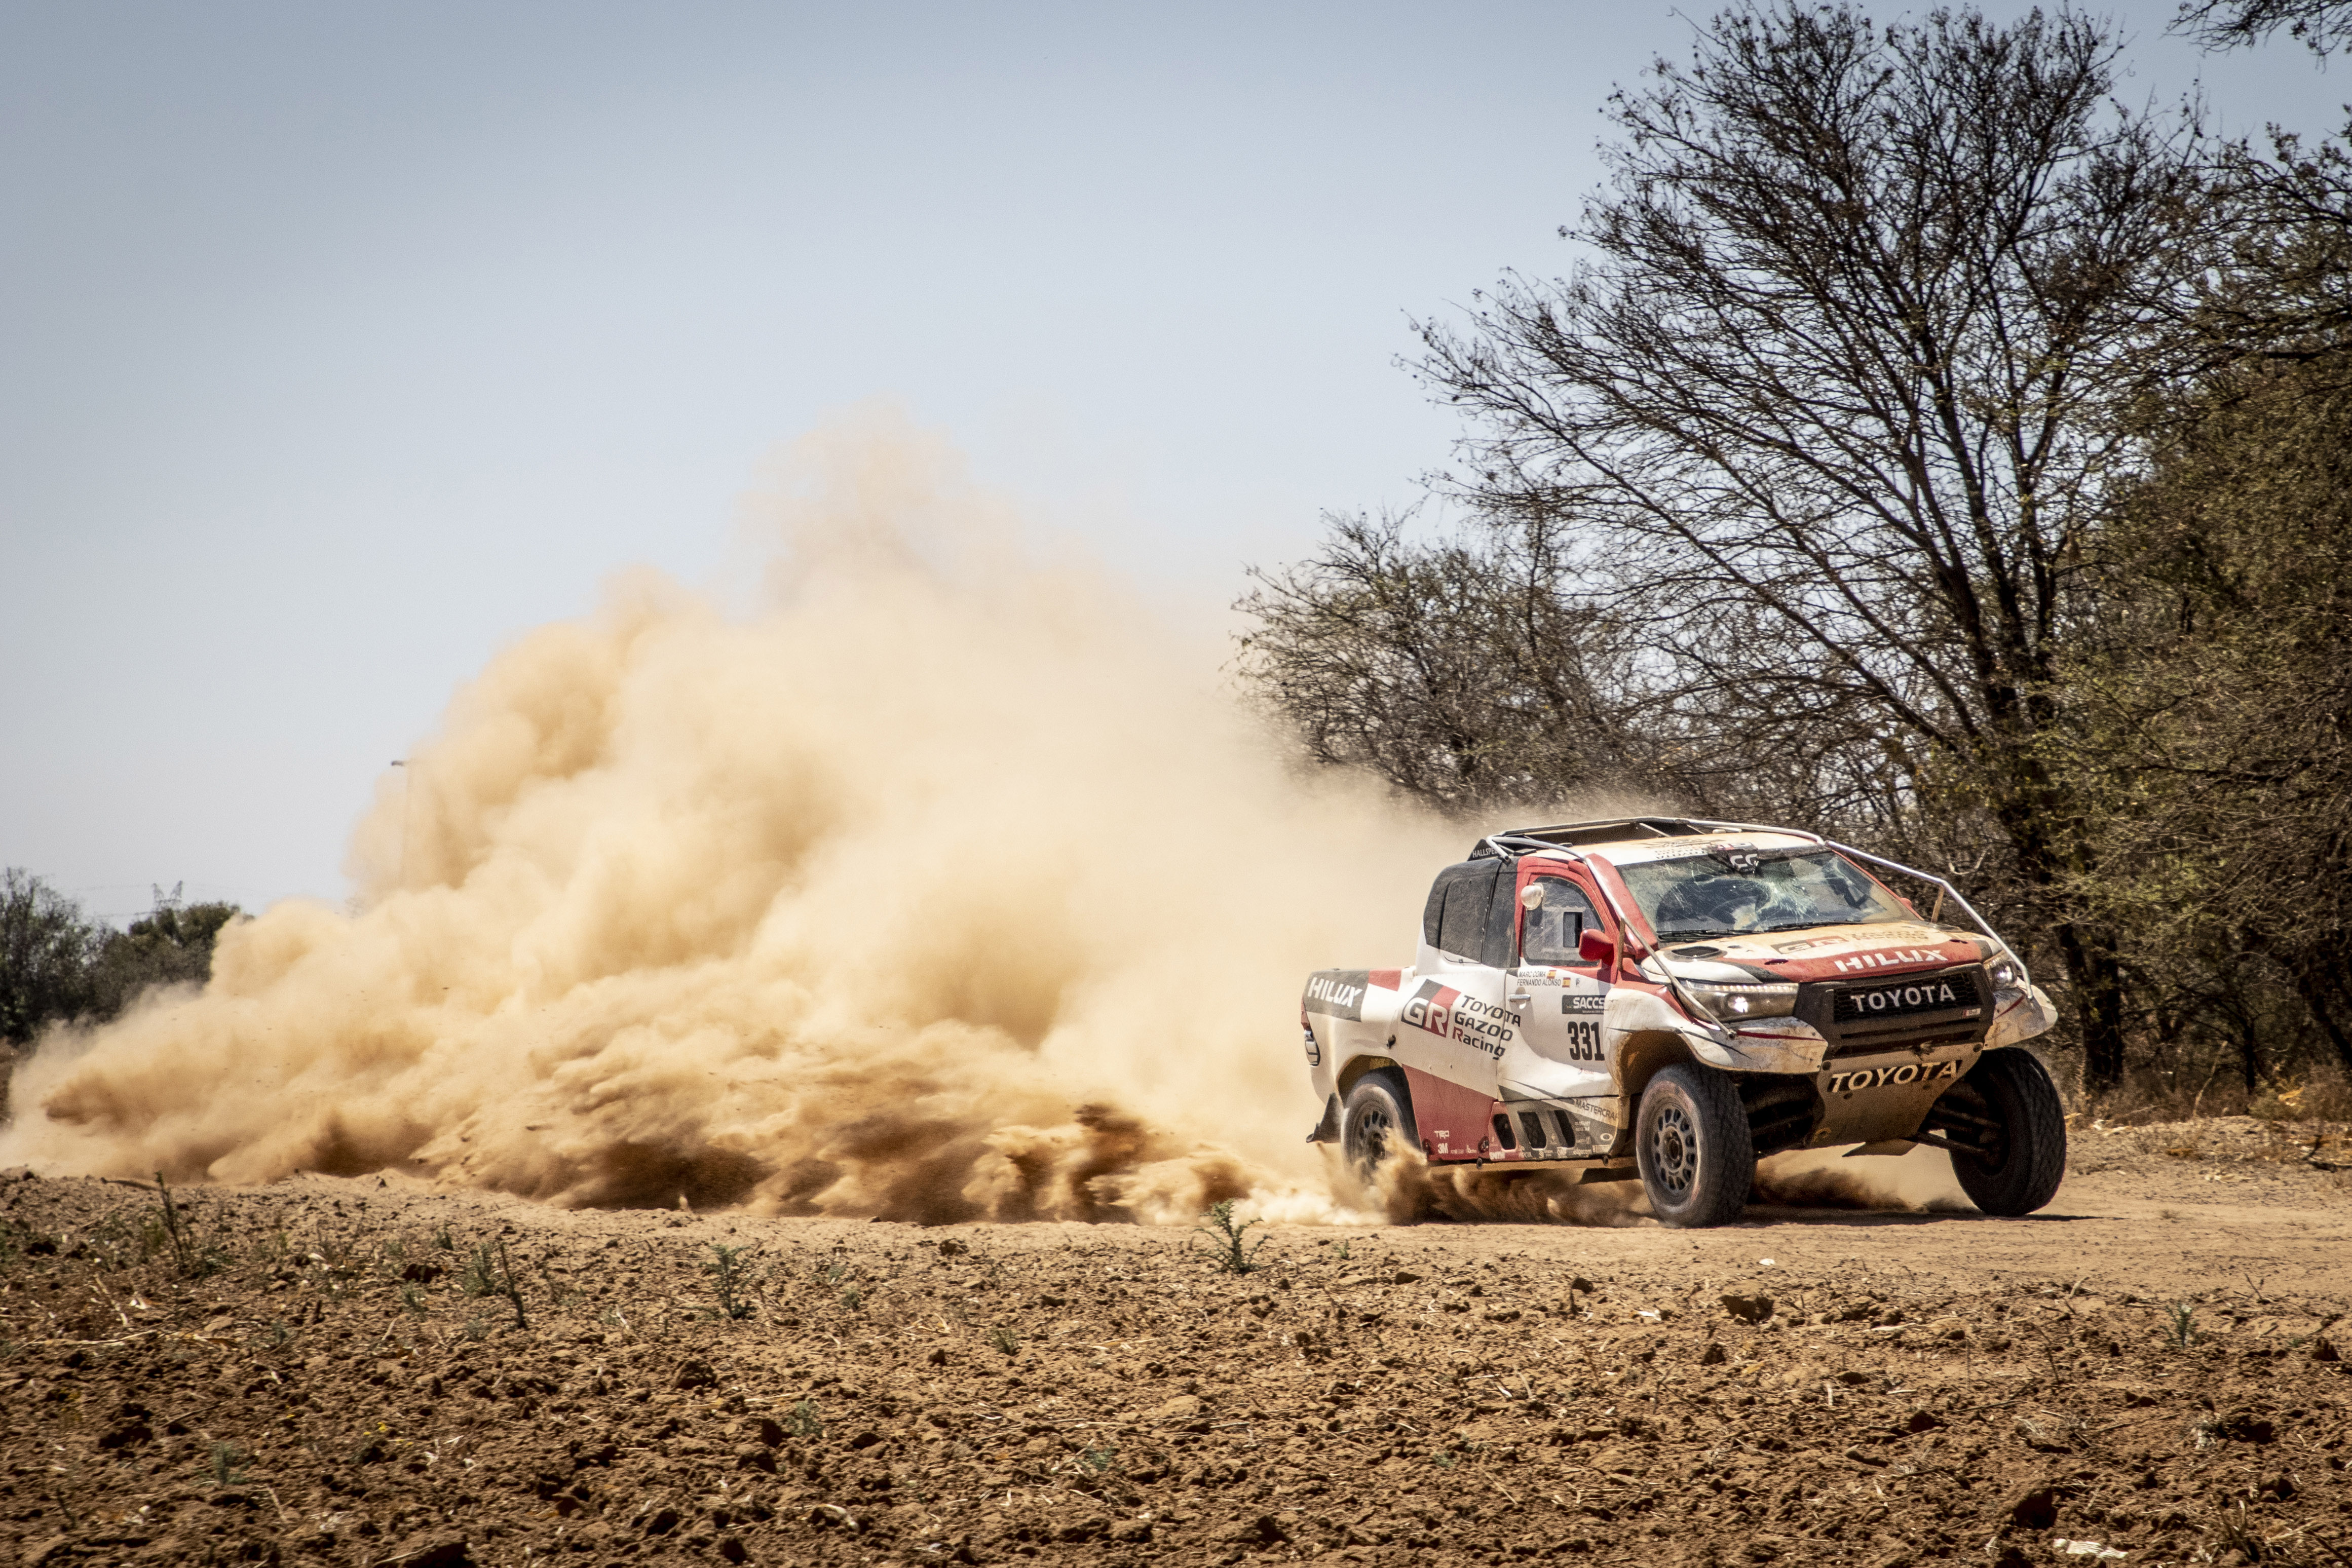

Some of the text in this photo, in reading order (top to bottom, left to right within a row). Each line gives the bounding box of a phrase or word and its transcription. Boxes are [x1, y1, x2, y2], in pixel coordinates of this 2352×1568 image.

[1834, 949, 1949, 972] HILUX
[1308, 977, 1362, 1007] HILUX
[1850, 984, 1956, 1012] TOYOTA
[1404, 997, 1448, 1035] GR
[1455, 1011, 1513, 1041] GAZOO
[1461, 995, 1521, 1027] TOYOTA
[1452, 1026, 1505, 1060] Racing
[1568, 1021, 1605, 1061] 331
[1831, 1060, 1958, 1093] TOYOTA
[1437, 1143, 1449, 1154] 3M
